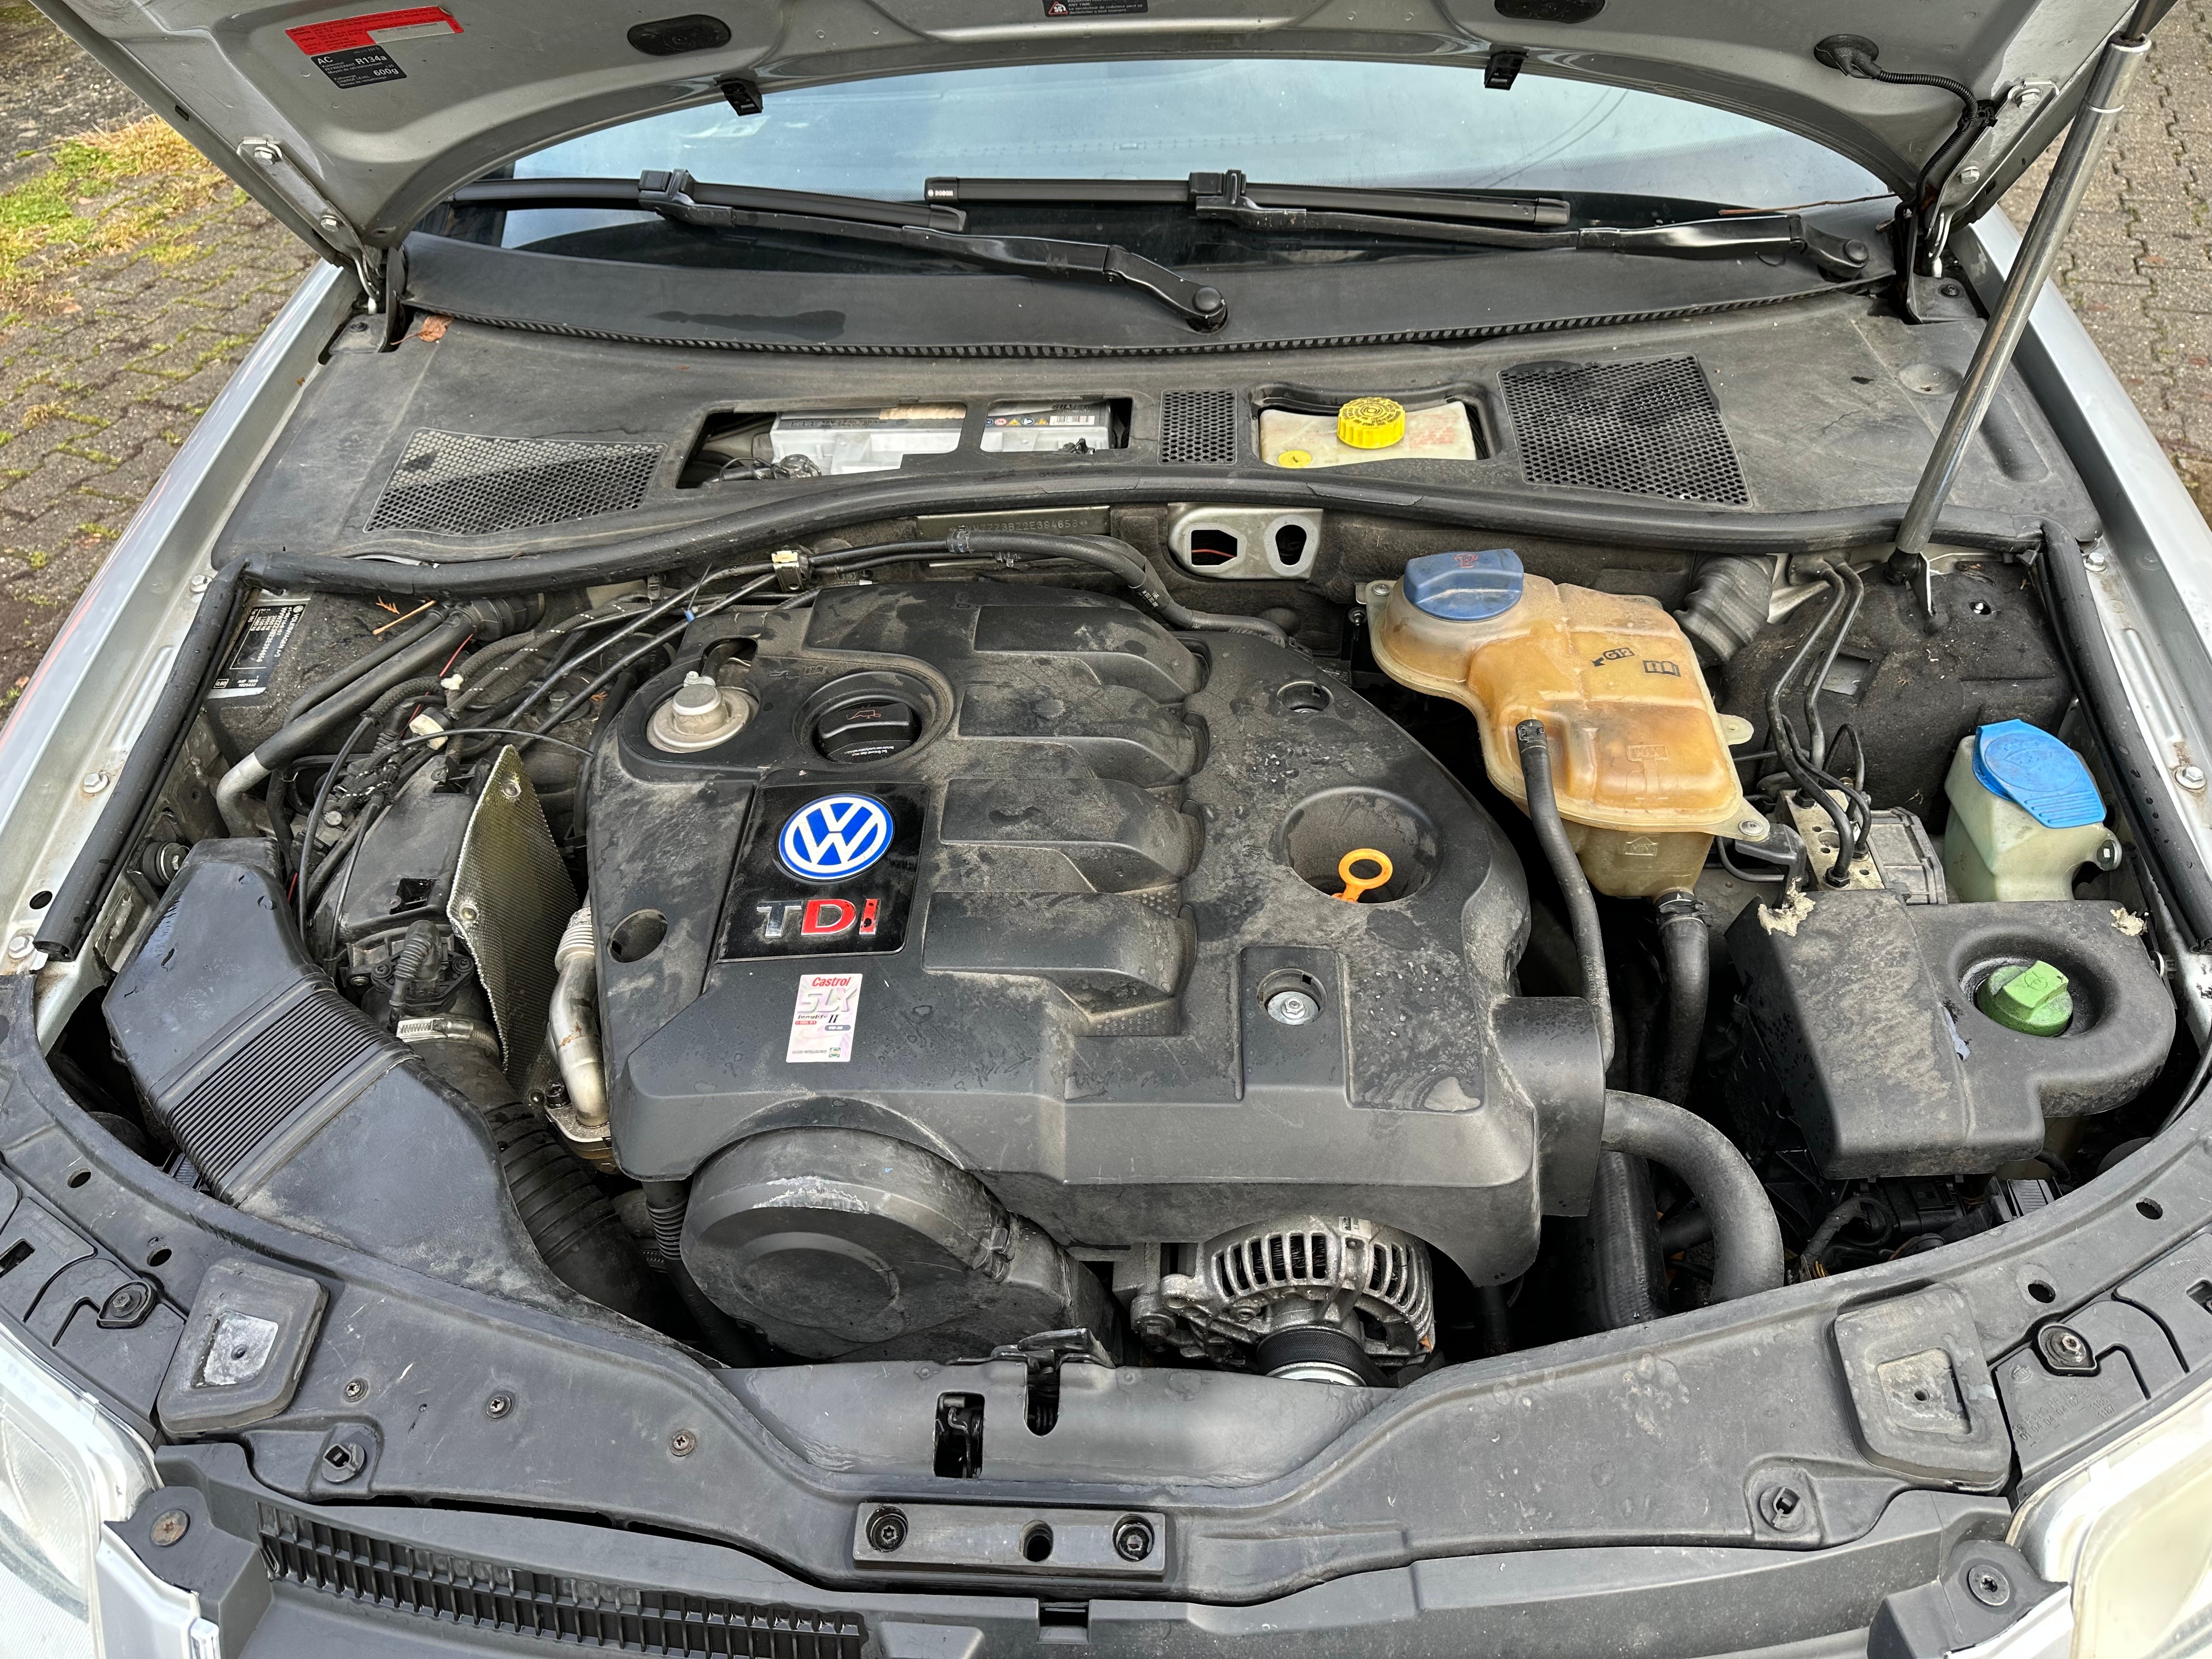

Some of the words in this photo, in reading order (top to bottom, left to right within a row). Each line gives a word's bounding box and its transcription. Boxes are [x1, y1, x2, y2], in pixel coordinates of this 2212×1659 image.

[317, 57, 333, 65] AC
[355, 55, 387, 65] R134a
[374, 68, 399, 76] 600g
[278, 613, 300, 649] VOLKSWAGEN
[1605, 648, 1633, 659] G12
[756, 898, 881, 938] TDI
[812, 977, 852, 986] Castrol
[797, 988, 858, 1013] SLX
